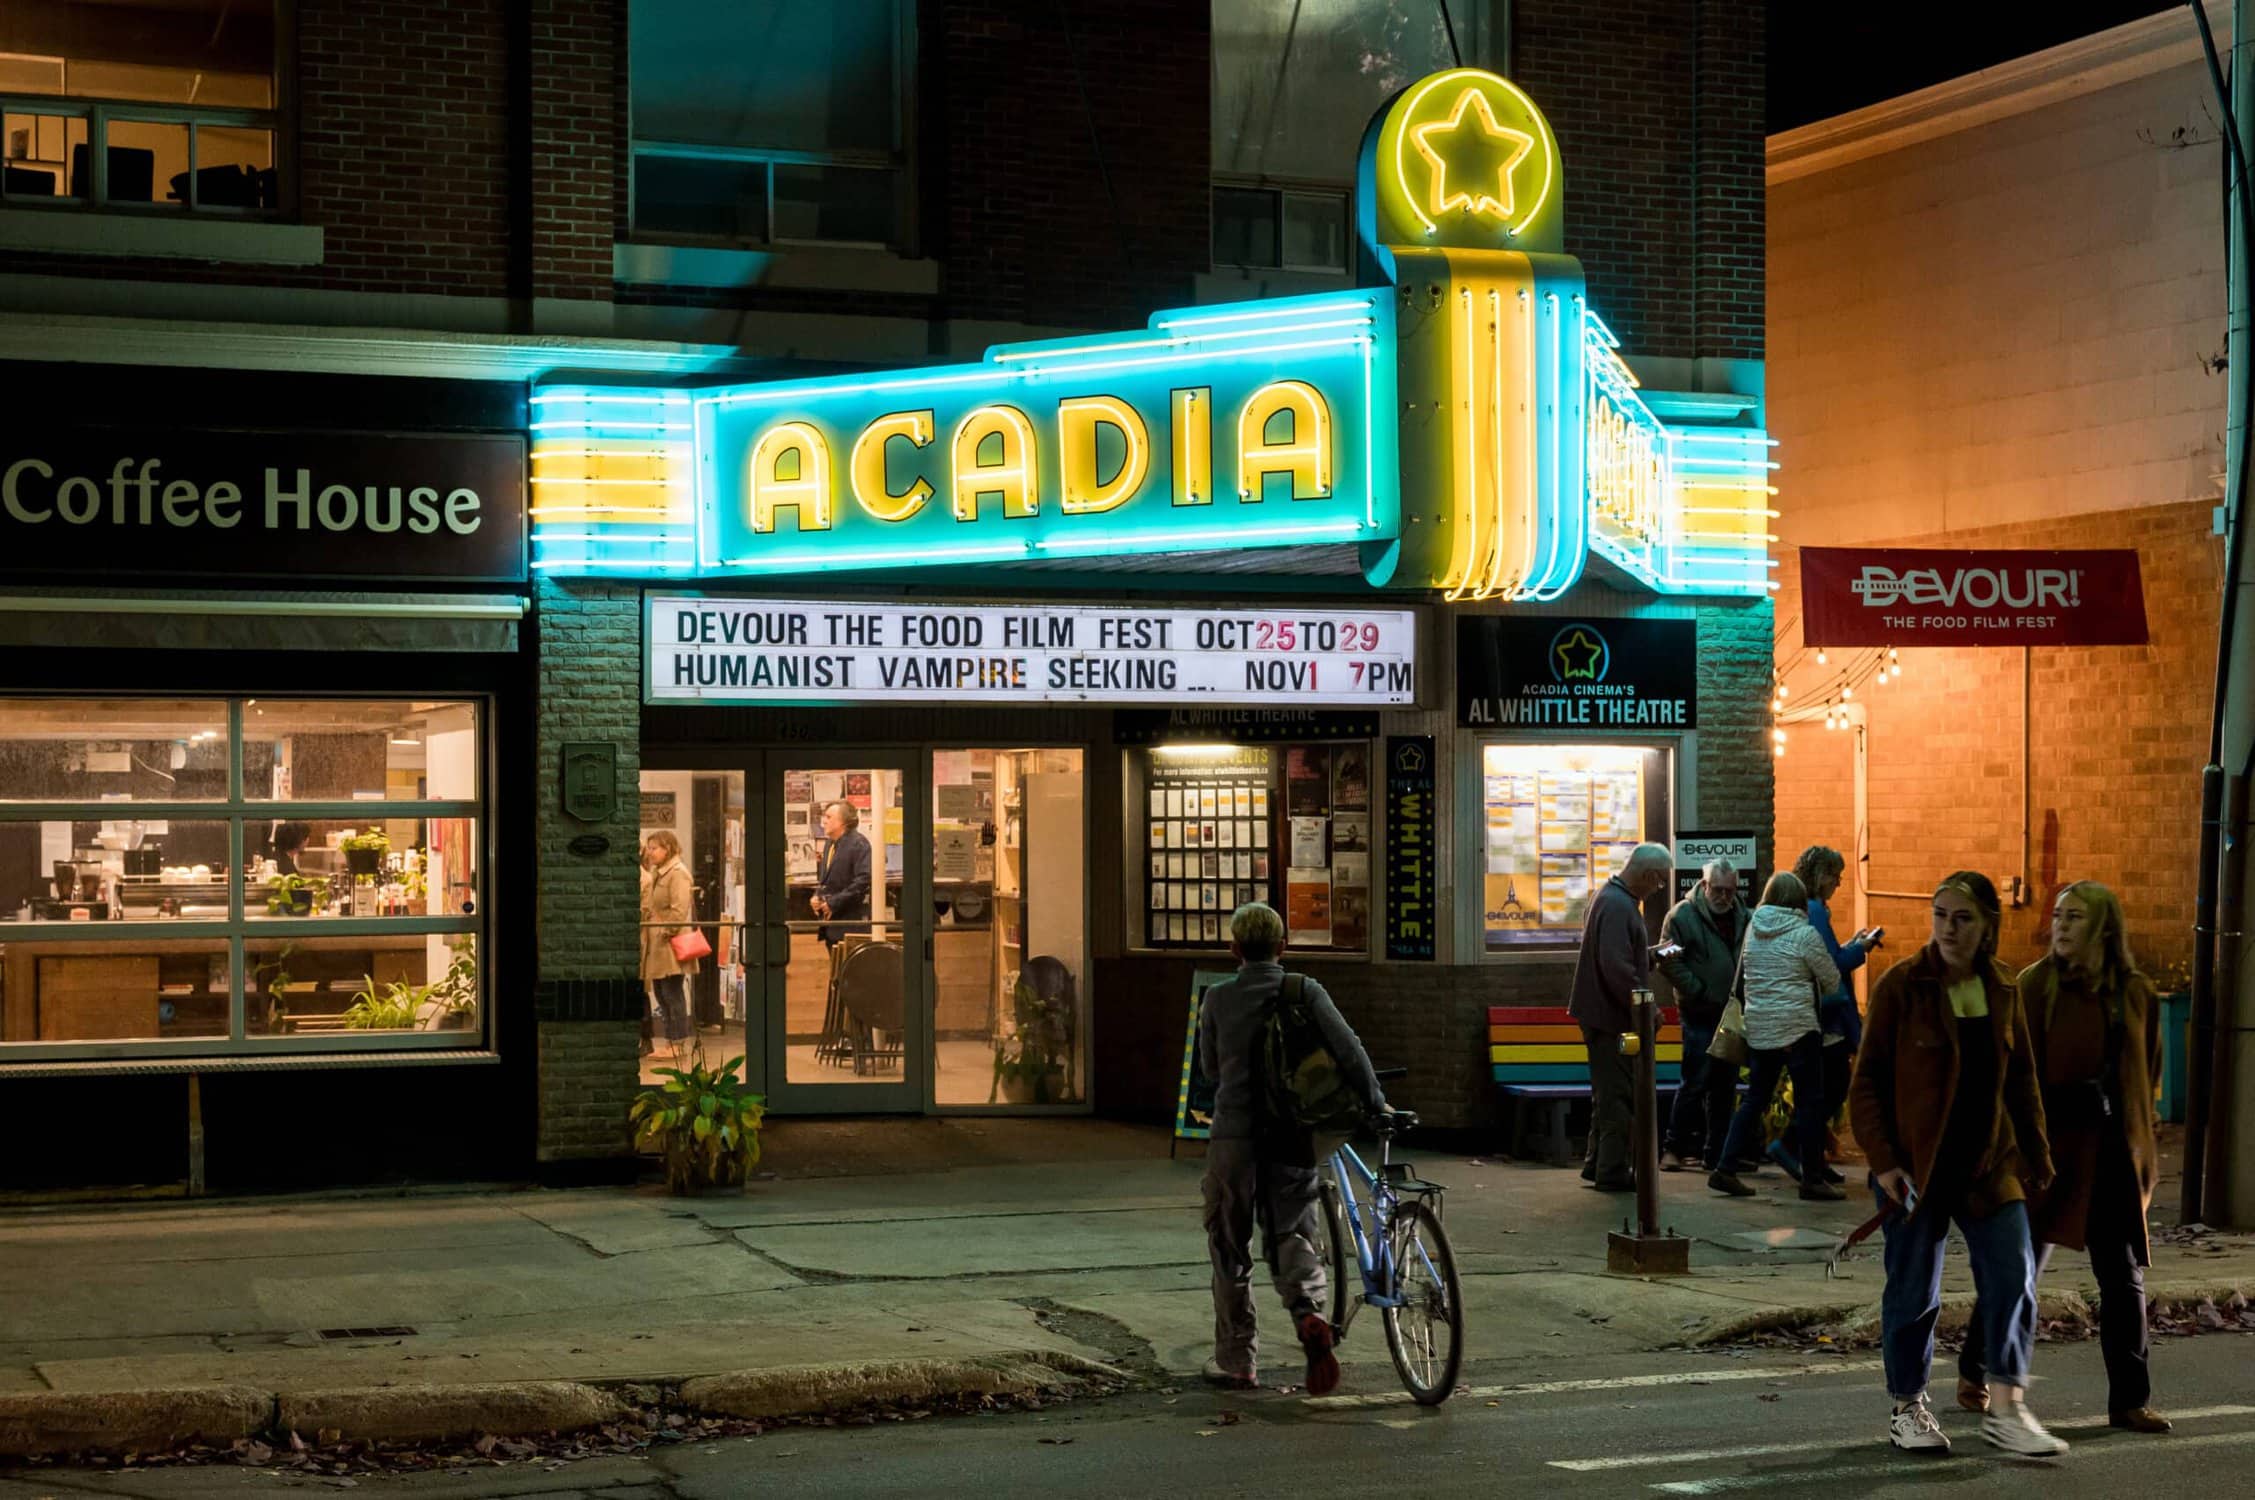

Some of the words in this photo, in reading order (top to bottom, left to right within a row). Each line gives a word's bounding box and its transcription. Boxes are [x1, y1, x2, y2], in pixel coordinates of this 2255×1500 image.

[750, 380, 1332, 533] ACADIA
[2, 458, 242, 527] Coffee
[265, 468, 481, 535] House
[1852, 566, 2080, 608] DEVOUR!
[677, 610, 808, 645] DEVOUR
[824, 614, 883, 646] THE
[902, 614, 983, 647] FOOD
[1003, 616, 1074, 648] FILM
[1100, 618, 1172, 649] FEST
[1883, 616, 1915, 628] THE
[1922, 616, 1967, 629] FOOD
[1974, 616, 2010, 629] FILM
[2016, 616, 2057, 628] FEST
[674, 653, 855, 687] HUMANIST
[878, 656, 1027, 689] VAMPIRE
[1048, 658, 1177, 690] SEEKING
[1348, 661, 1412, 692] 7PM
[1522, 684, 1569, 695] ACADIA
[1573, 684, 1635, 695] CINEMA'S
[1468, 698, 1495, 723] AL
[1498, 698, 1590, 723] WHITTLE
[1595, 699, 1687, 724] THEATRE
[1401, 793, 1421, 938] WHITTLE
